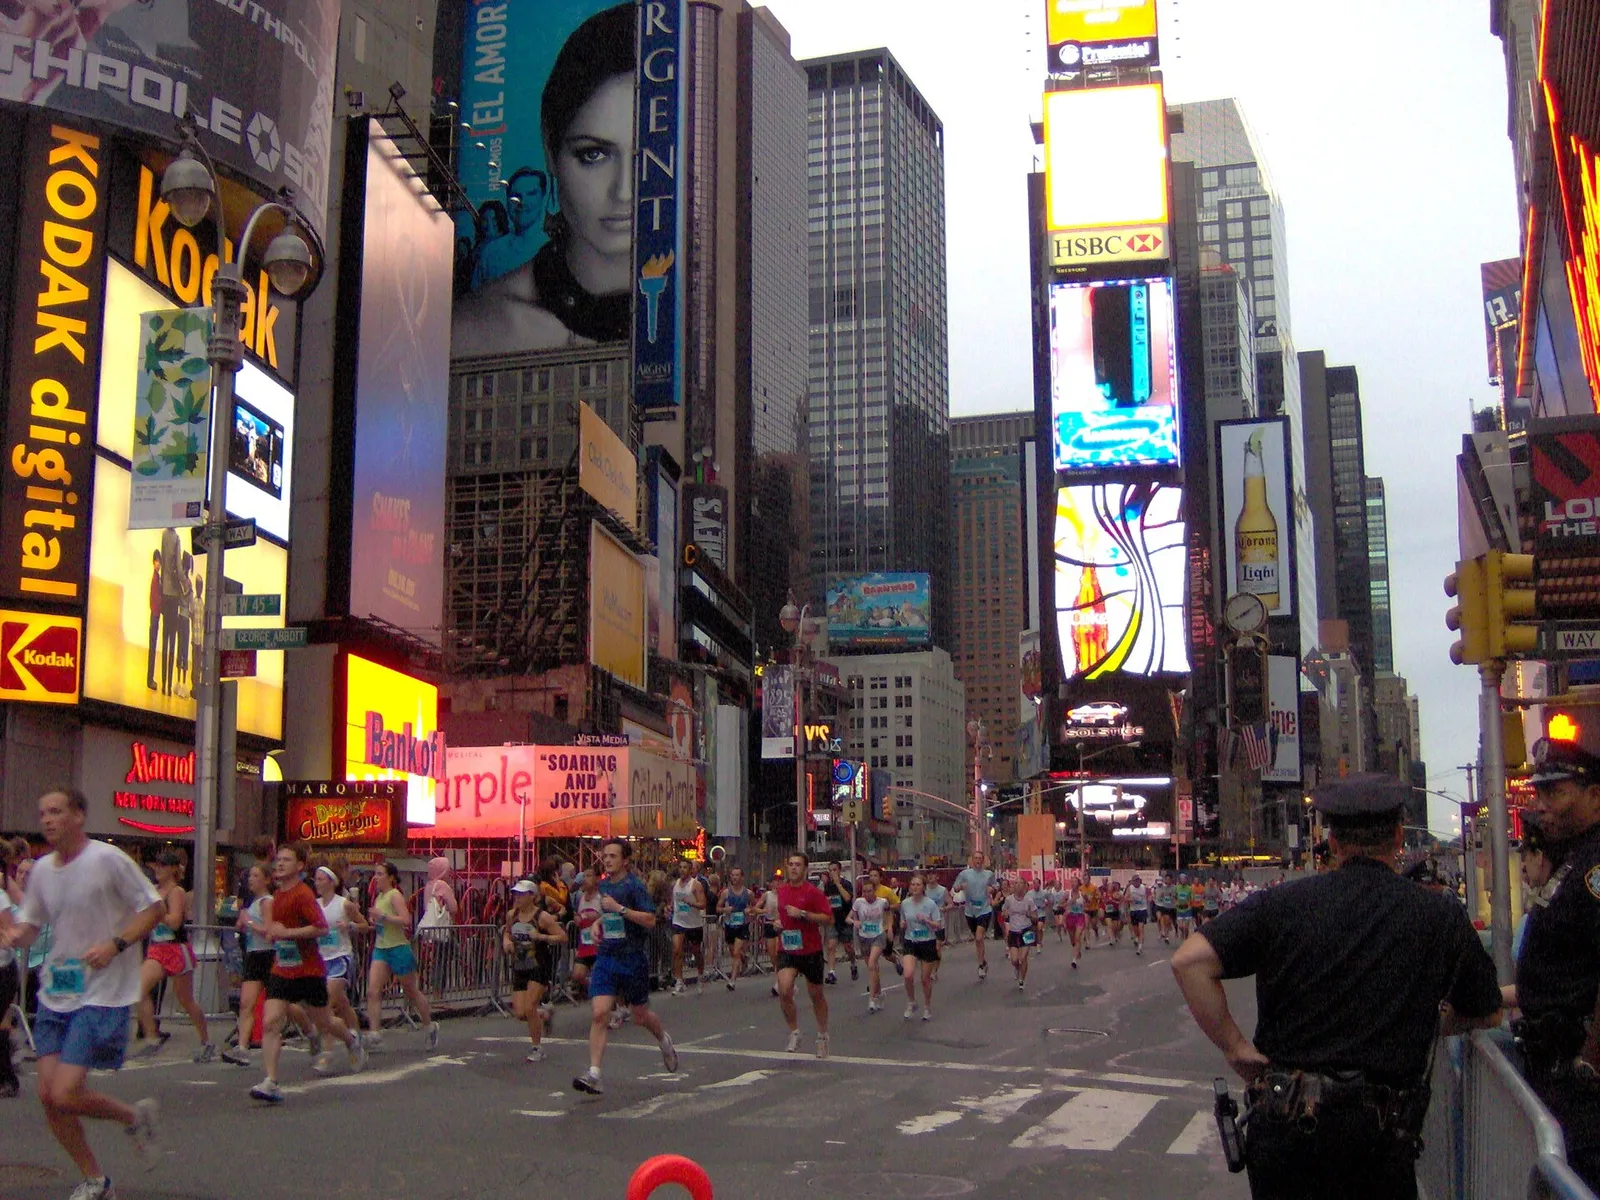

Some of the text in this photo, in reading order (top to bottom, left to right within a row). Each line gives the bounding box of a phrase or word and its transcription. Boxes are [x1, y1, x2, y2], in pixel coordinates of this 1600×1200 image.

[473, 3, 508, 84] AMOR
[472, 91, 505, 126] EL
[1054, 235, 1122, 258] HSBC
[12, 124, 100, 597] KODAK digital
[229, 527, 249, 540] WAY
[1546, 521, 1597, 537] THE
[1242, 564, 1275, 582] Light
[240, 596, 249, 613] W
[252, 596, 266, 613] 45
[238, 629, 305, 643] GEORGE ABBOTT
[1563, 632, 1596, 648] WAY
[24, 648, 75, 668] Kodak
[365, 710, 417, 774] Bank
[577, 733, 628, 745] VISTA MEDIA
[286, 783, 395, 794] MARQUIS
[565, 773, 597, 790] AND
[114, 790, 138, 808] NEW
[139, 794, 167, 811] YORK
